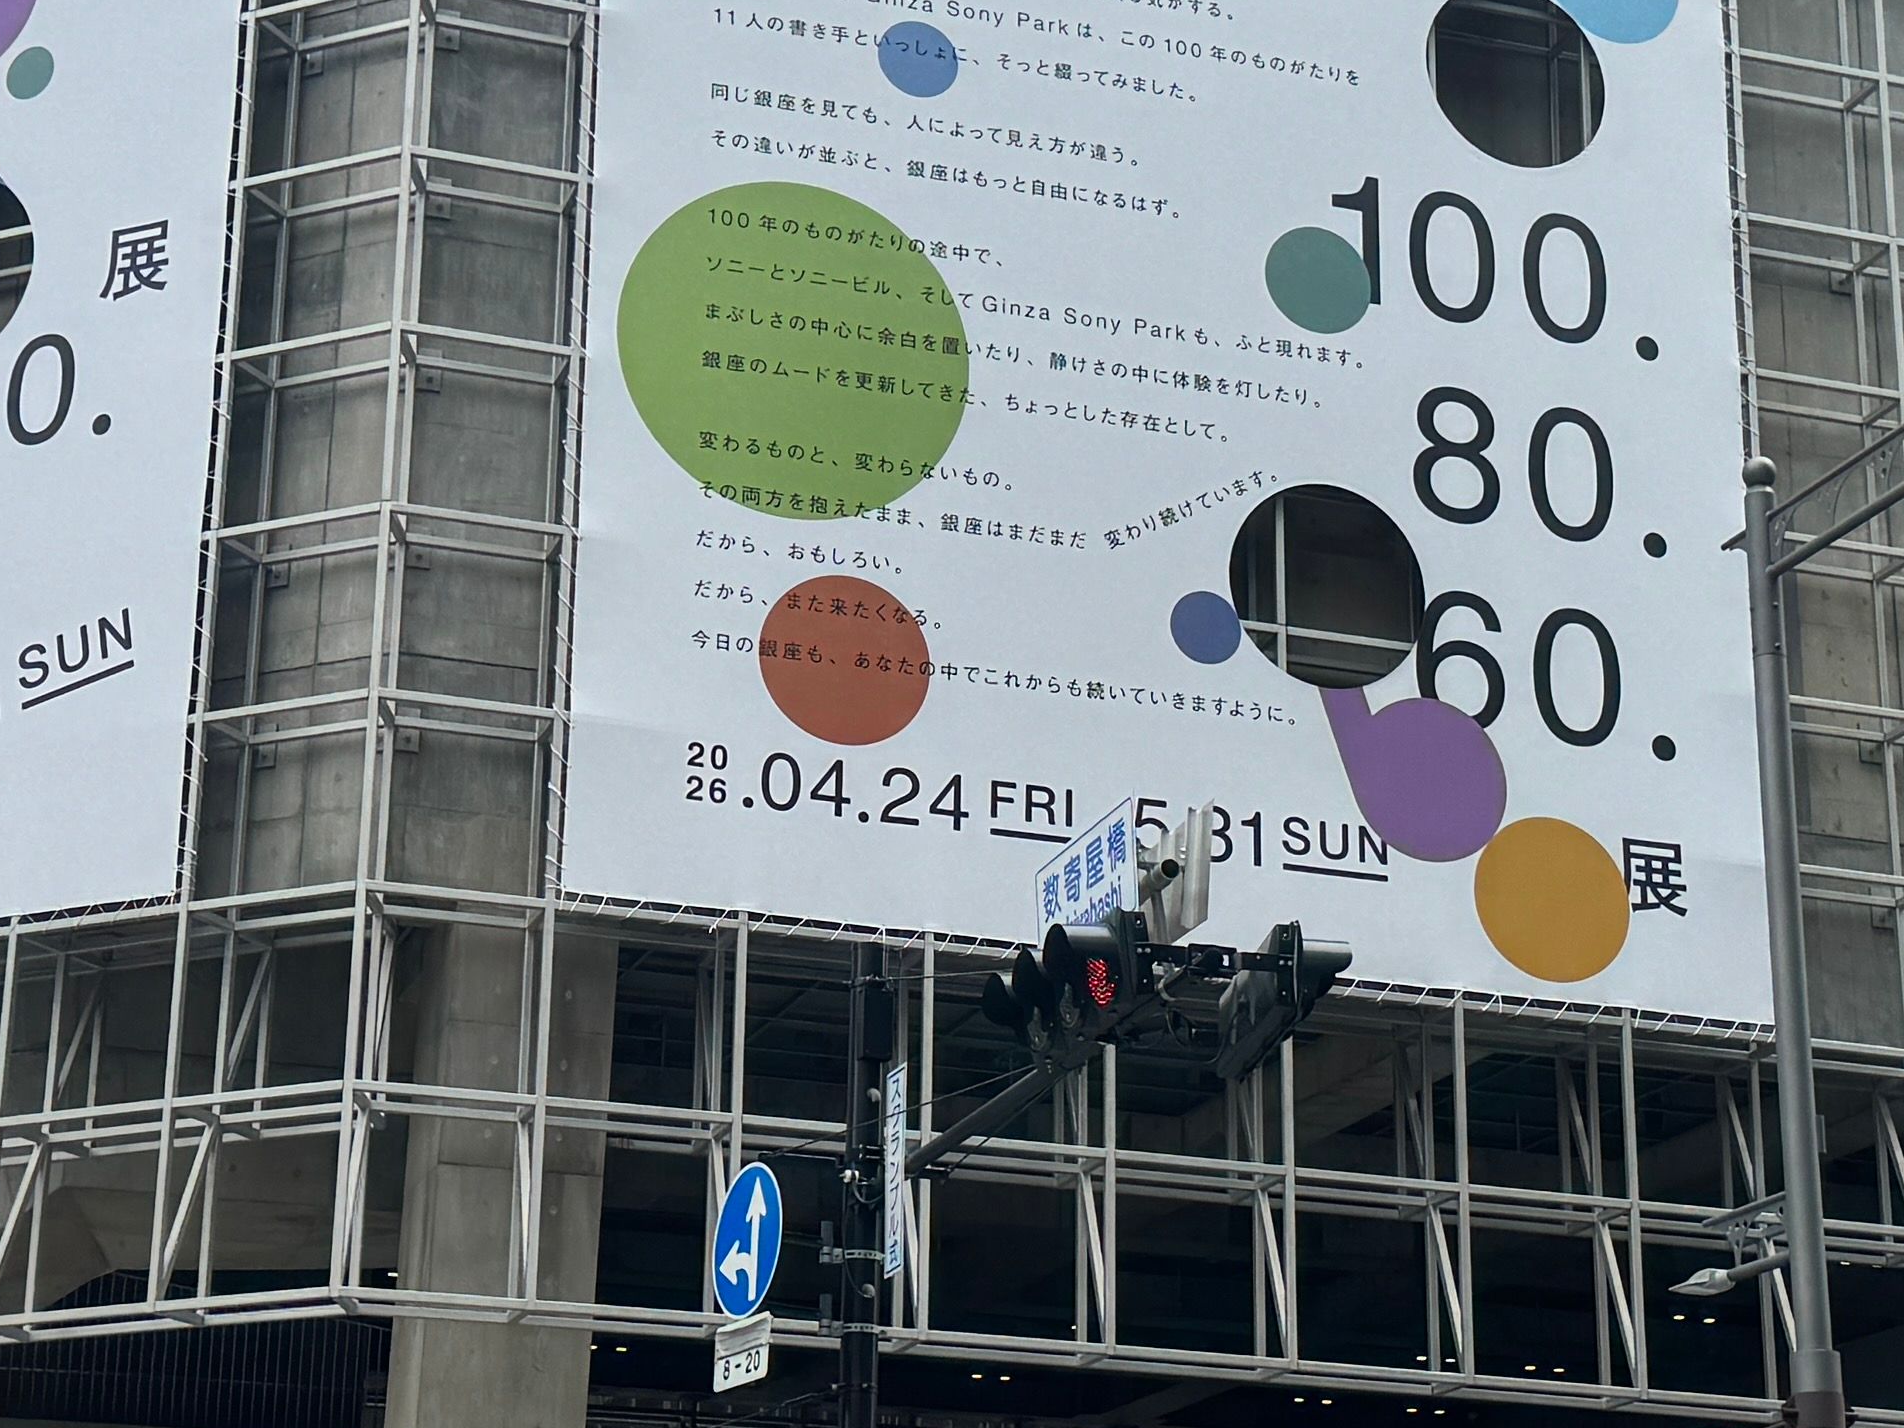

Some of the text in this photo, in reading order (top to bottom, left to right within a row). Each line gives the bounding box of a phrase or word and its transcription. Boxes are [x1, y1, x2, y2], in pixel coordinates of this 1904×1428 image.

[946, 0, 1005, 31] Sony
[99, 220, 170, 301] 展
[1331, 176, 1659, 362] 100.
[1063, 305, 1123, 338] Sony
[1413, 386, 1668, 558] 80.
[696, 530, 903, 575] だから、おもしろい。
[17, 607, 133, 690] SUN
[1415, 590, 1677, 761] 60.
[686, 776, 728, 805] 26
[687, 742, 729, 770] 20
[990, 780, 1074, 828] FRI
[1135, 799, 1264, 867] 531
[1282, 817, 1389, 866] SUN
[1042, 817, 1127, 923] 数寄屋橋
[1622, 836, 1688, 917] 展
